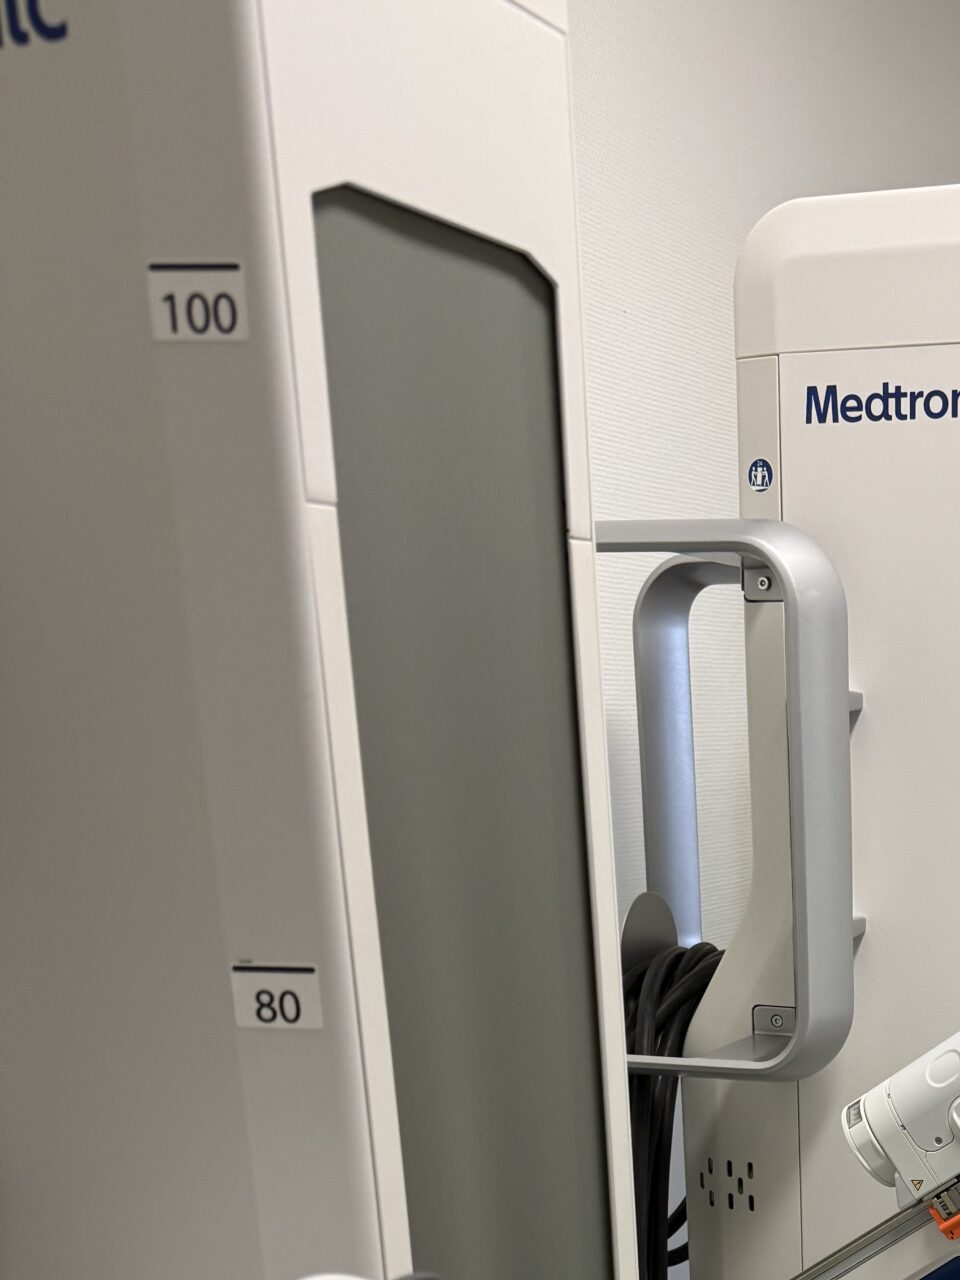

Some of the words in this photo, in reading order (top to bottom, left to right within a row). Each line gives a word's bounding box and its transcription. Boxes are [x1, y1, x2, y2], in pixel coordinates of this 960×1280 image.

[0, 0, 68, 47] ic
[162, 291, 238, 335] 100
[256, 989, 301, 1023] 80
